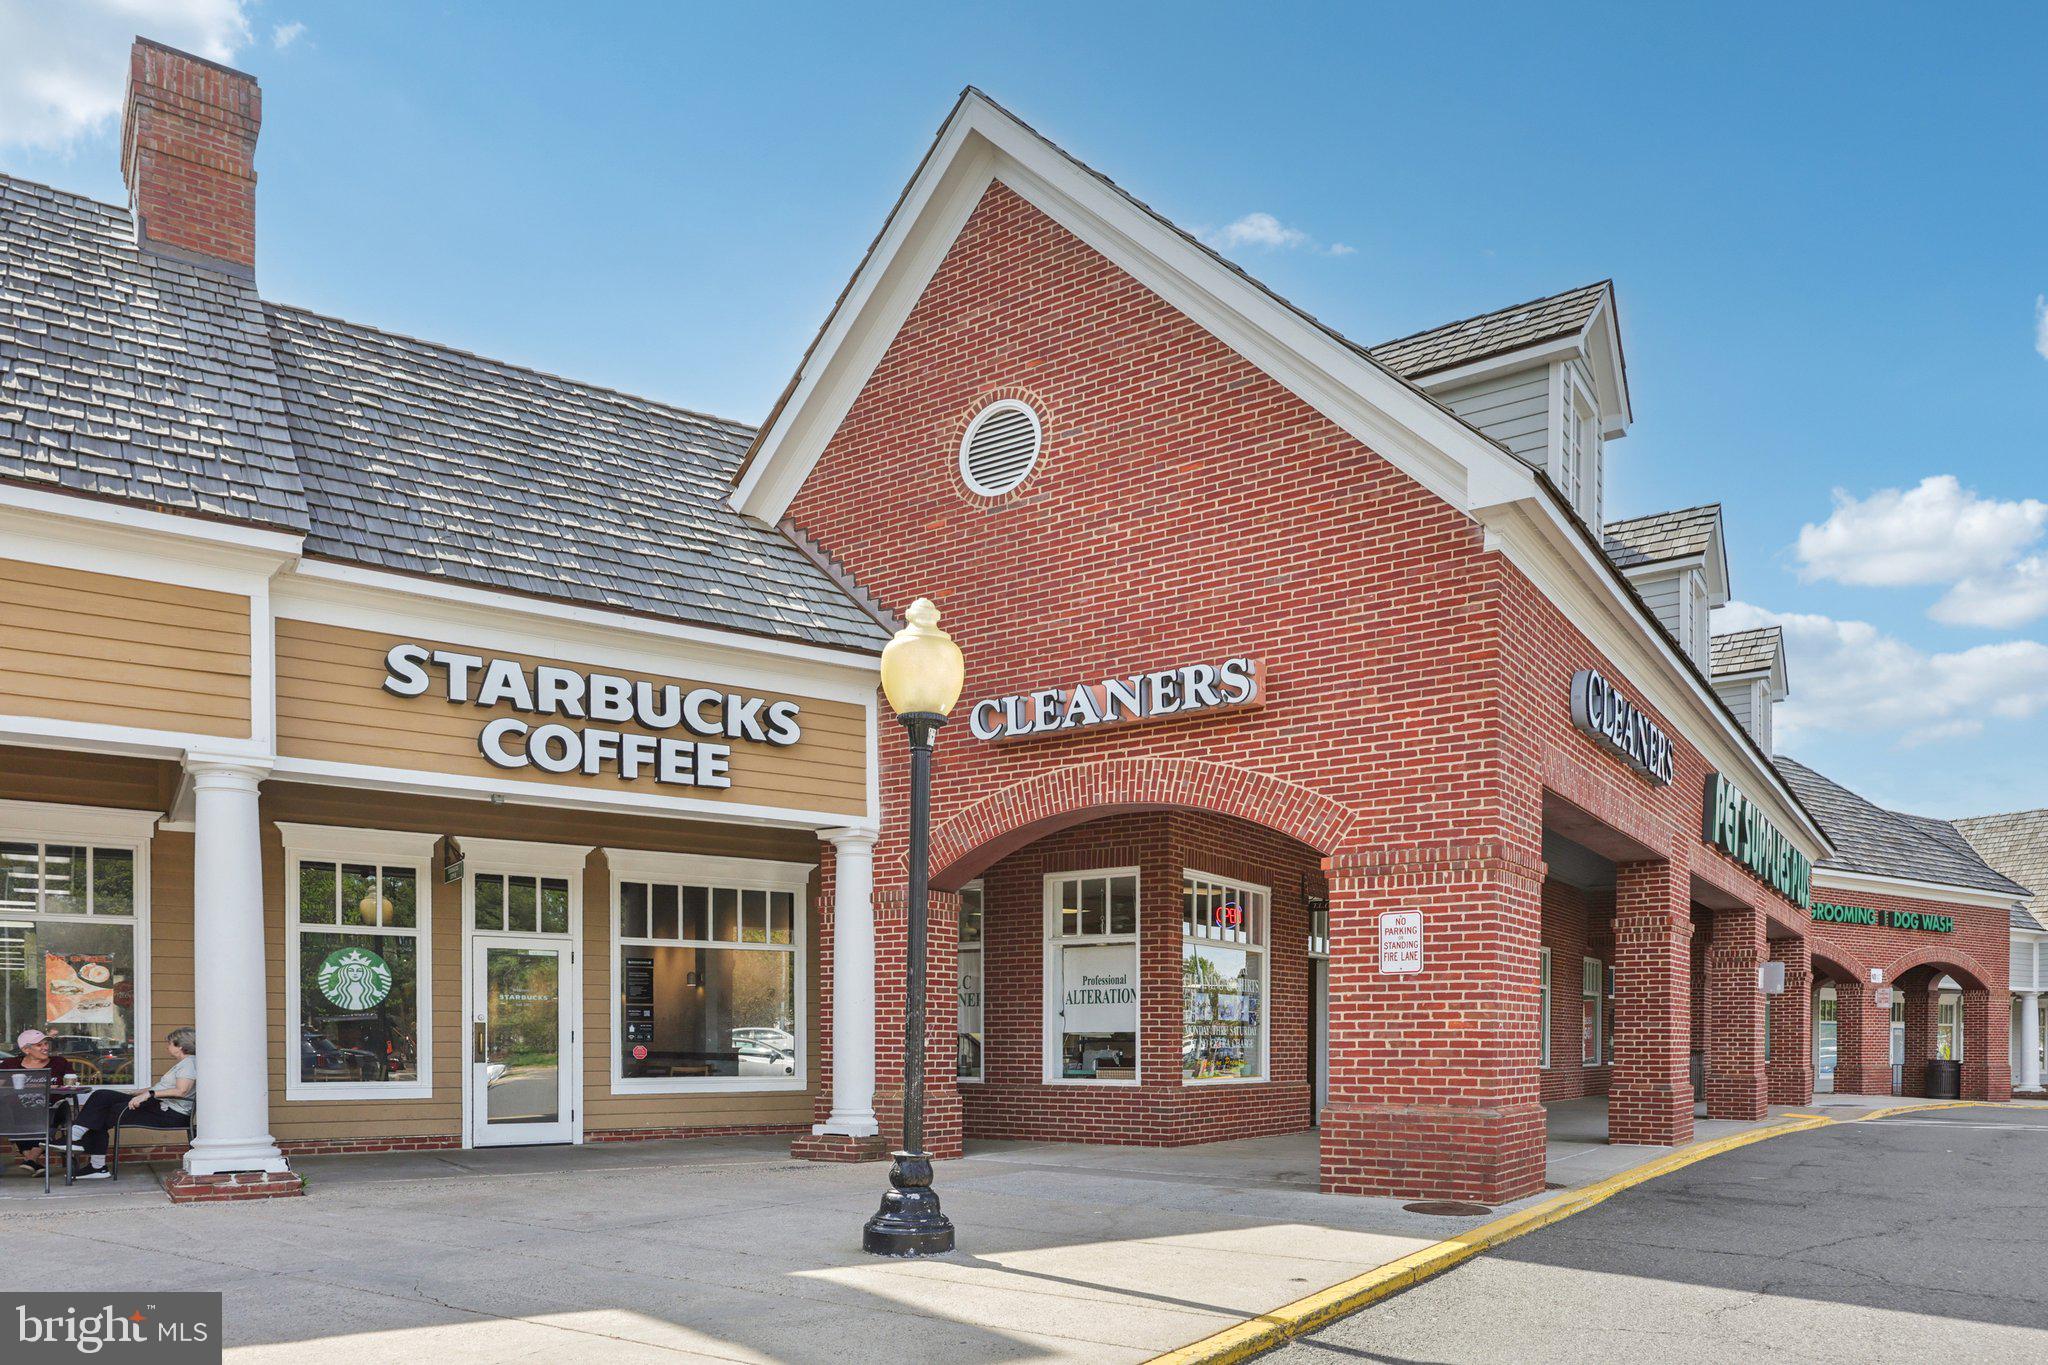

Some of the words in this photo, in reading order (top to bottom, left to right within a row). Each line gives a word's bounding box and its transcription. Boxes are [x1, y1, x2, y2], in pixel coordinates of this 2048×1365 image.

[383, 643, 801, 746] STARBUCKS
[969, 658, 1257, 741] CLEANERS
[1586, 669, 1674, 786] CLEANERS
[477, 717, 732, 789] COFFEE
[1713, 771, 1742, 858] PET
[1743, 799, 1791, 895] SUPPLIES
[1384, 926, 1418, 936] PARKING
[1395, 917, 1406, 926] NO
[1894, 911, 1919, 929] DOG
[1921, 914, 1954, 932] WASH
[1383, 941, 1419, 950] STANDING
[1383, 952, 1398, 962] FIRE
[1400, 951, 1419, 961] LANE
[1082, 974, 1127, 986] Professional
[1065, 988, 1137, 1005] ALTERATION
